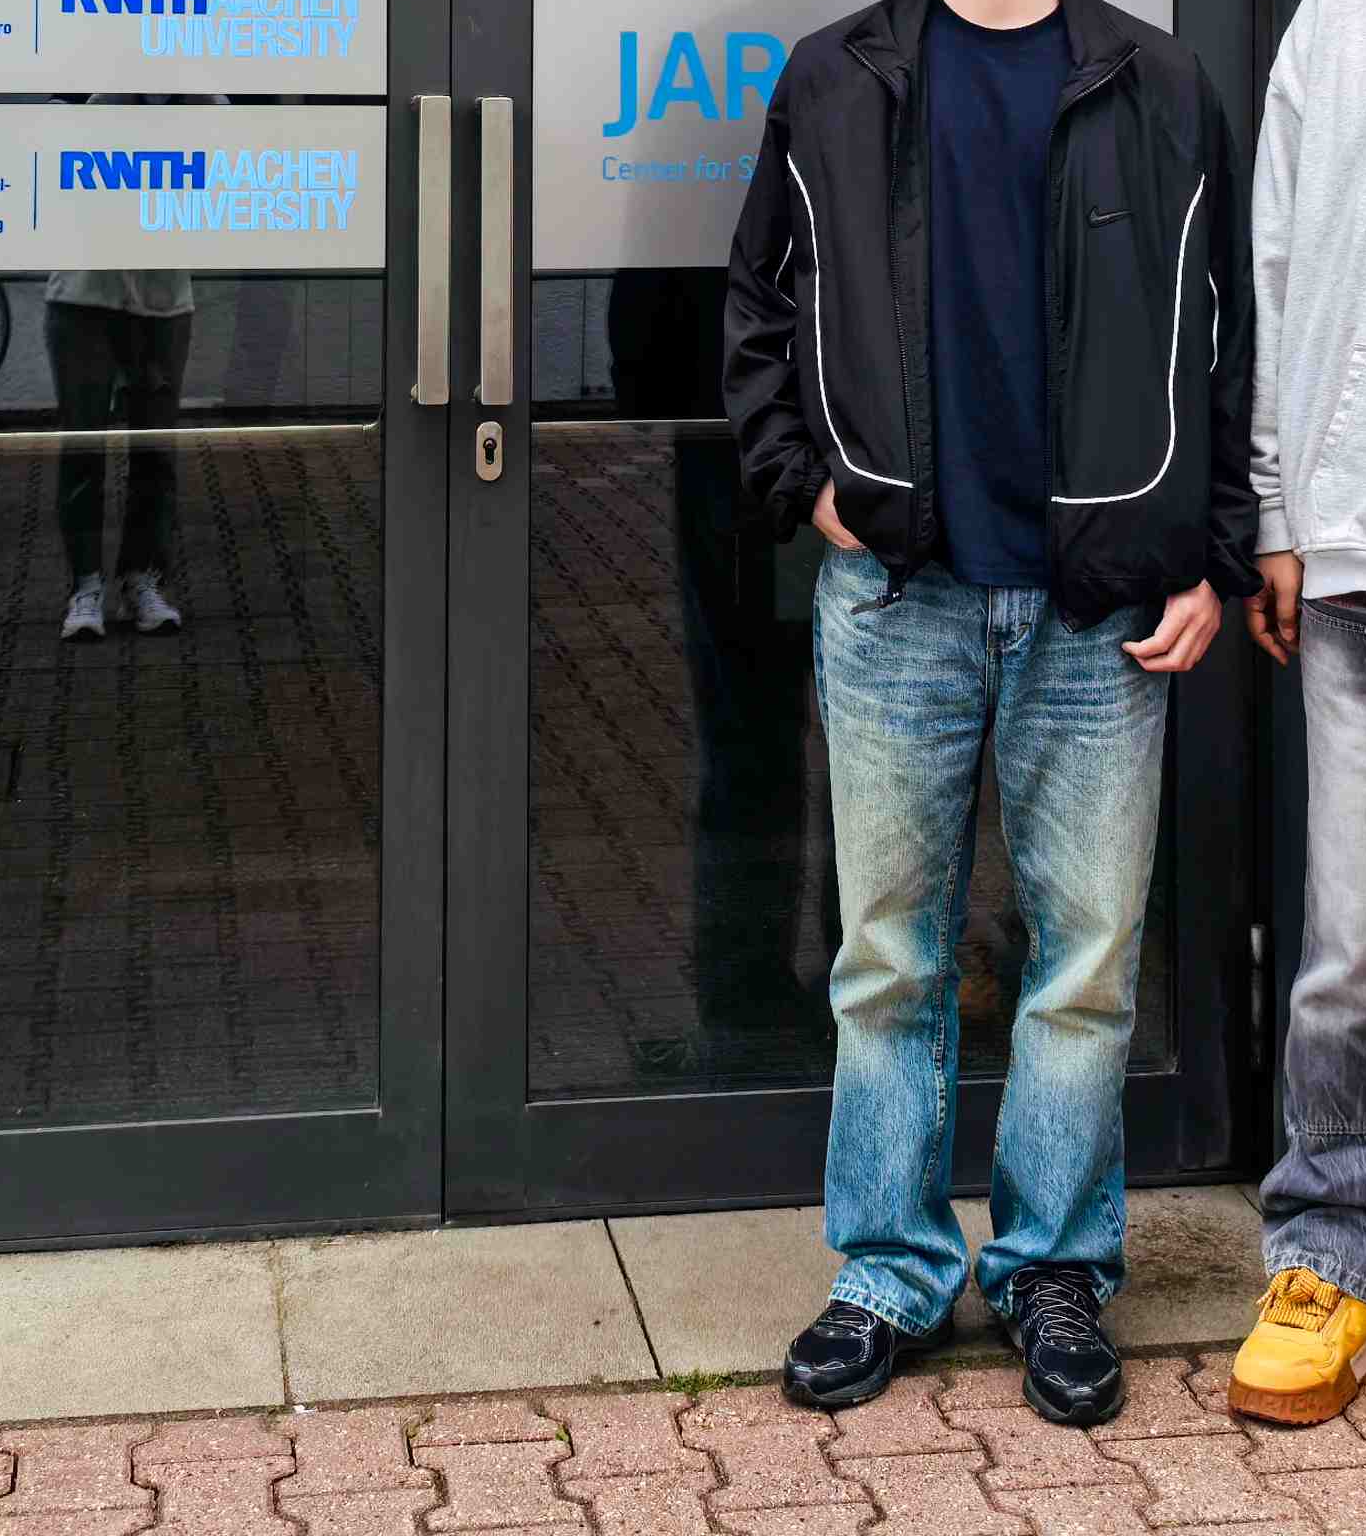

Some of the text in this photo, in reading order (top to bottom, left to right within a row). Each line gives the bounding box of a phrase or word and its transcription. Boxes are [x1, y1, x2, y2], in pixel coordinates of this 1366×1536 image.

[141, 17, 356, 58] UNIVERSITY
[60, 149, 358, 190] RWTH AACHEN
[140, 191, 356, 231] UNIVERSITY
